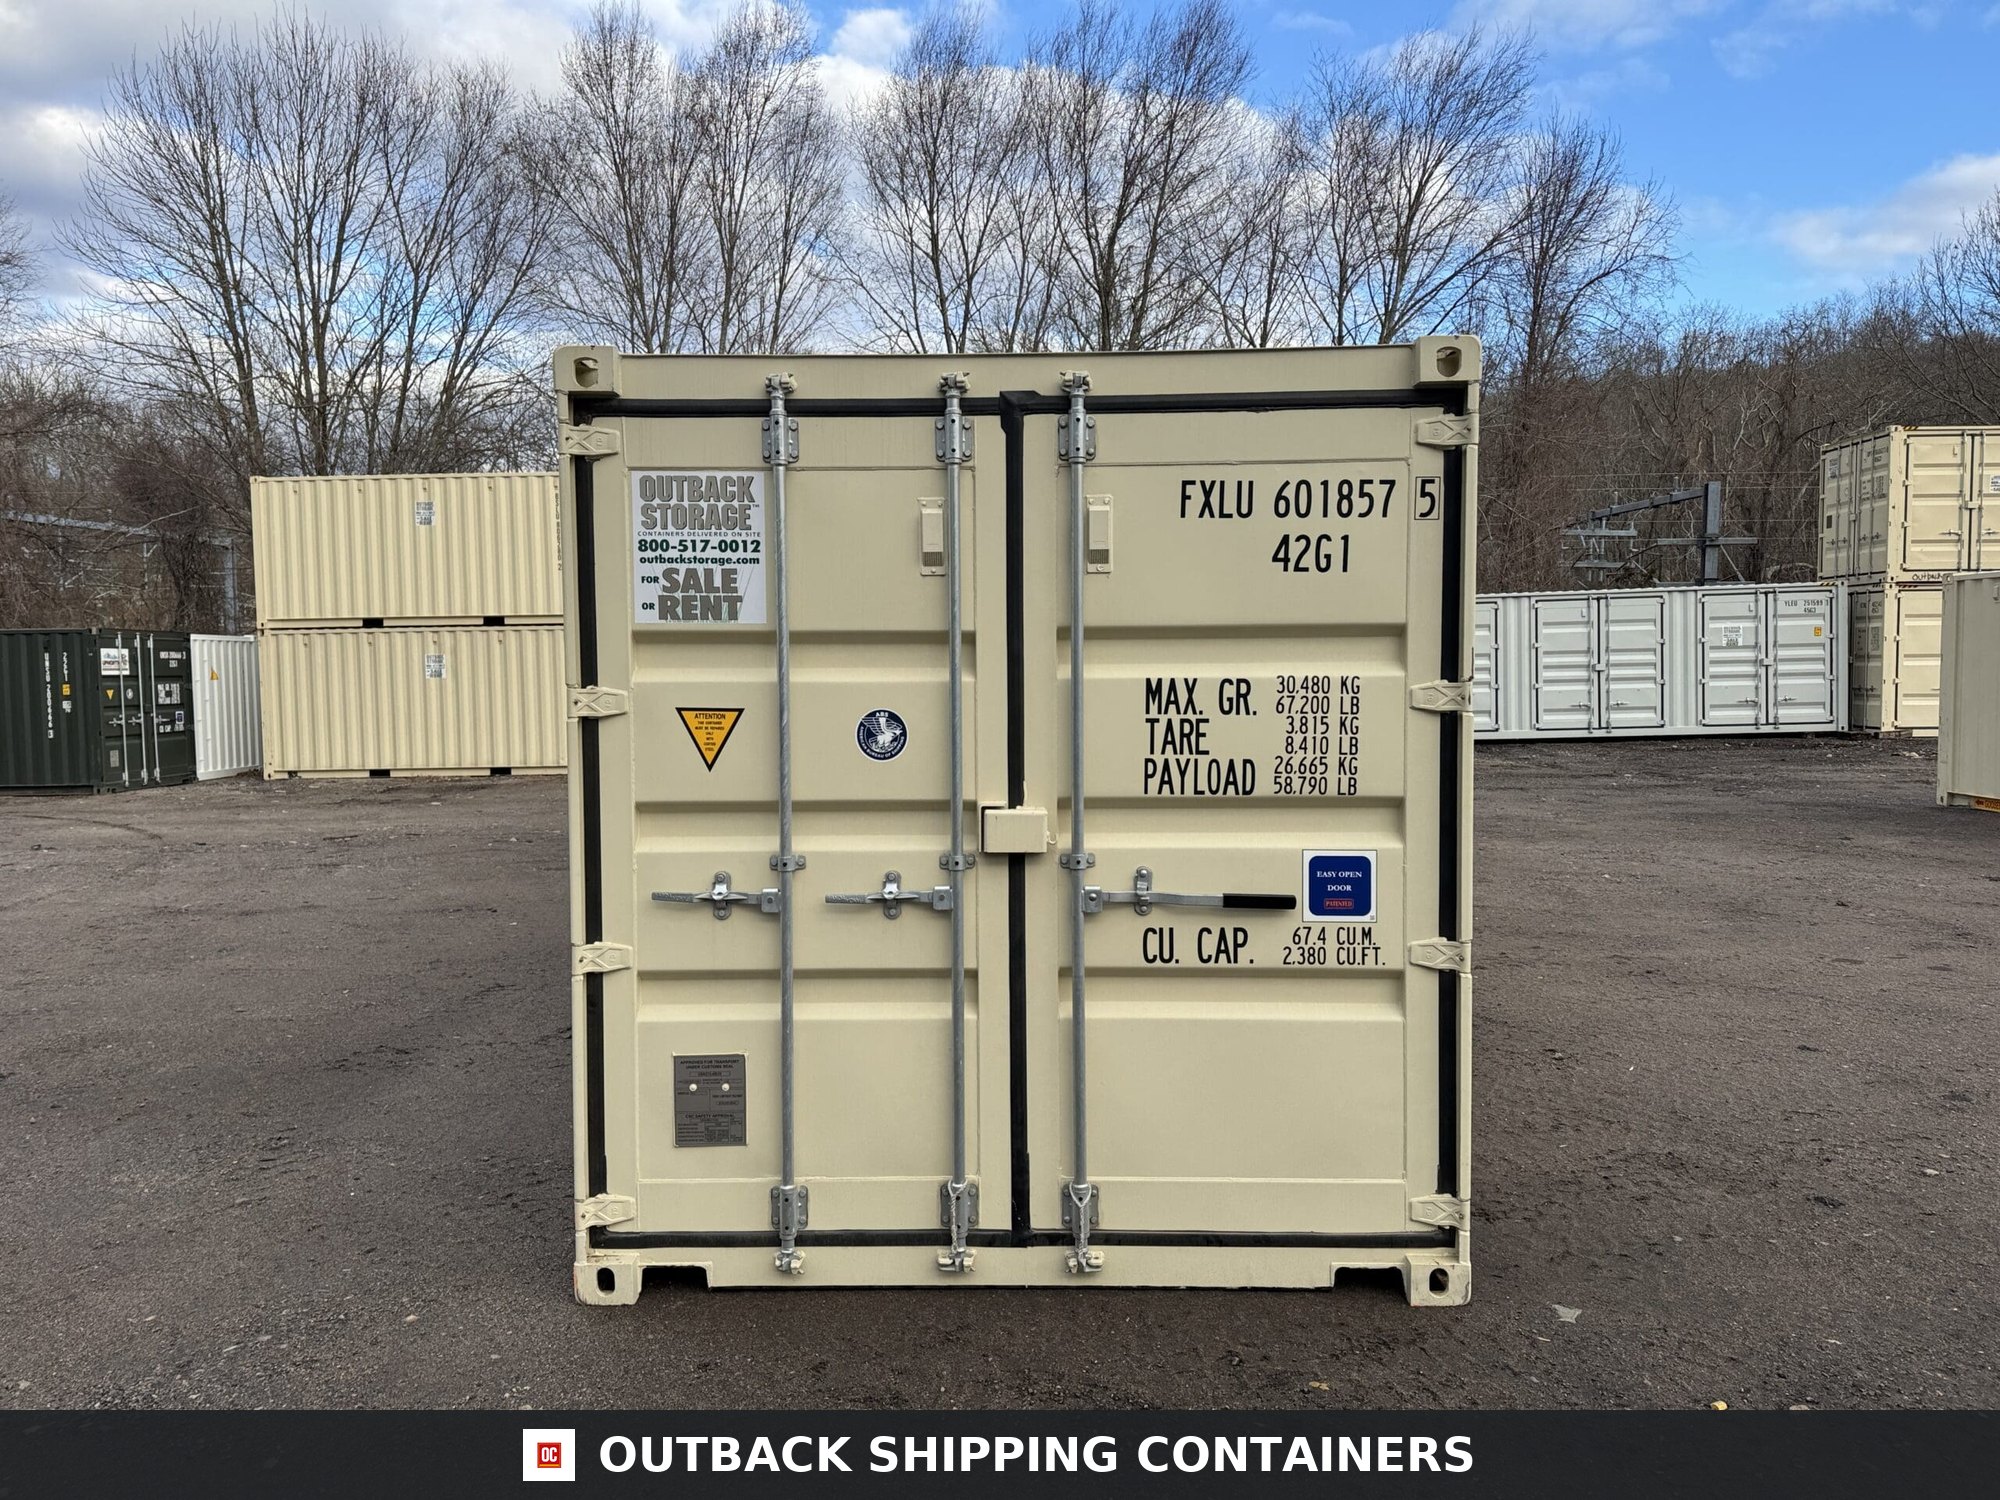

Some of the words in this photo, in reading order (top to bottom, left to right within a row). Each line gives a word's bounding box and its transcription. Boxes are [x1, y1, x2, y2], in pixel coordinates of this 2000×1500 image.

[639, 475, 756, 503] OUTBACK
[1181, 480, 1254, 518] FXLU
[1274, 479, 1397, 518] 601857
[1419, 479, 1436, 518] 5
[640, 503, 752, 531] STORAGE
[637, 539, 761, 553] 800-517-0012
[1272, 534, 1350, 572] 42G1
[639, 554, 760, 566] outbackstorage.com
[641, 576, 660, 584] FOR
[661, 567, 738, 594] SALE
[641, 602, 655, 610] OR
[658, 595, 743, 621] RENT
[1276, 675, 1331, 695] 30,480
[1340, 676, 1361, 695] KG
[1145, 678, 1203, 715] MAX.
[1219, 678, 1257, 716] GR.
[1276, 695, 1330, 715] 67,200
[1340, 696, 1360, 715] LB
[1145, 718, 1210, 755] TARE
[1286, 716, 1330, 735] 3,815
[1339, 716, 1359, 735] KG
[1285, 736, 1329, 755] 8,410
[1339, 737, 1359, 755] LB
[1144, 758, 1256, 796] PAYLOAD
[1274, 756, 1329, 775] 26,665
[1338, 757, 1358, 775] KG
[1273, 776, 1328, 796] 58,790
[1337, 777, 1358, 796] LB
[1143, 927, 1180, 964] CU.
[1197, 927, 1254, 964] CAP.
[1292, 927, 1327, 946] 67.4
[1336, 927, 1377, 946] CU.M.
[1282, 947, 1327, 965] 2,380
[1336, 947, 1386, 966] CU.FT.
